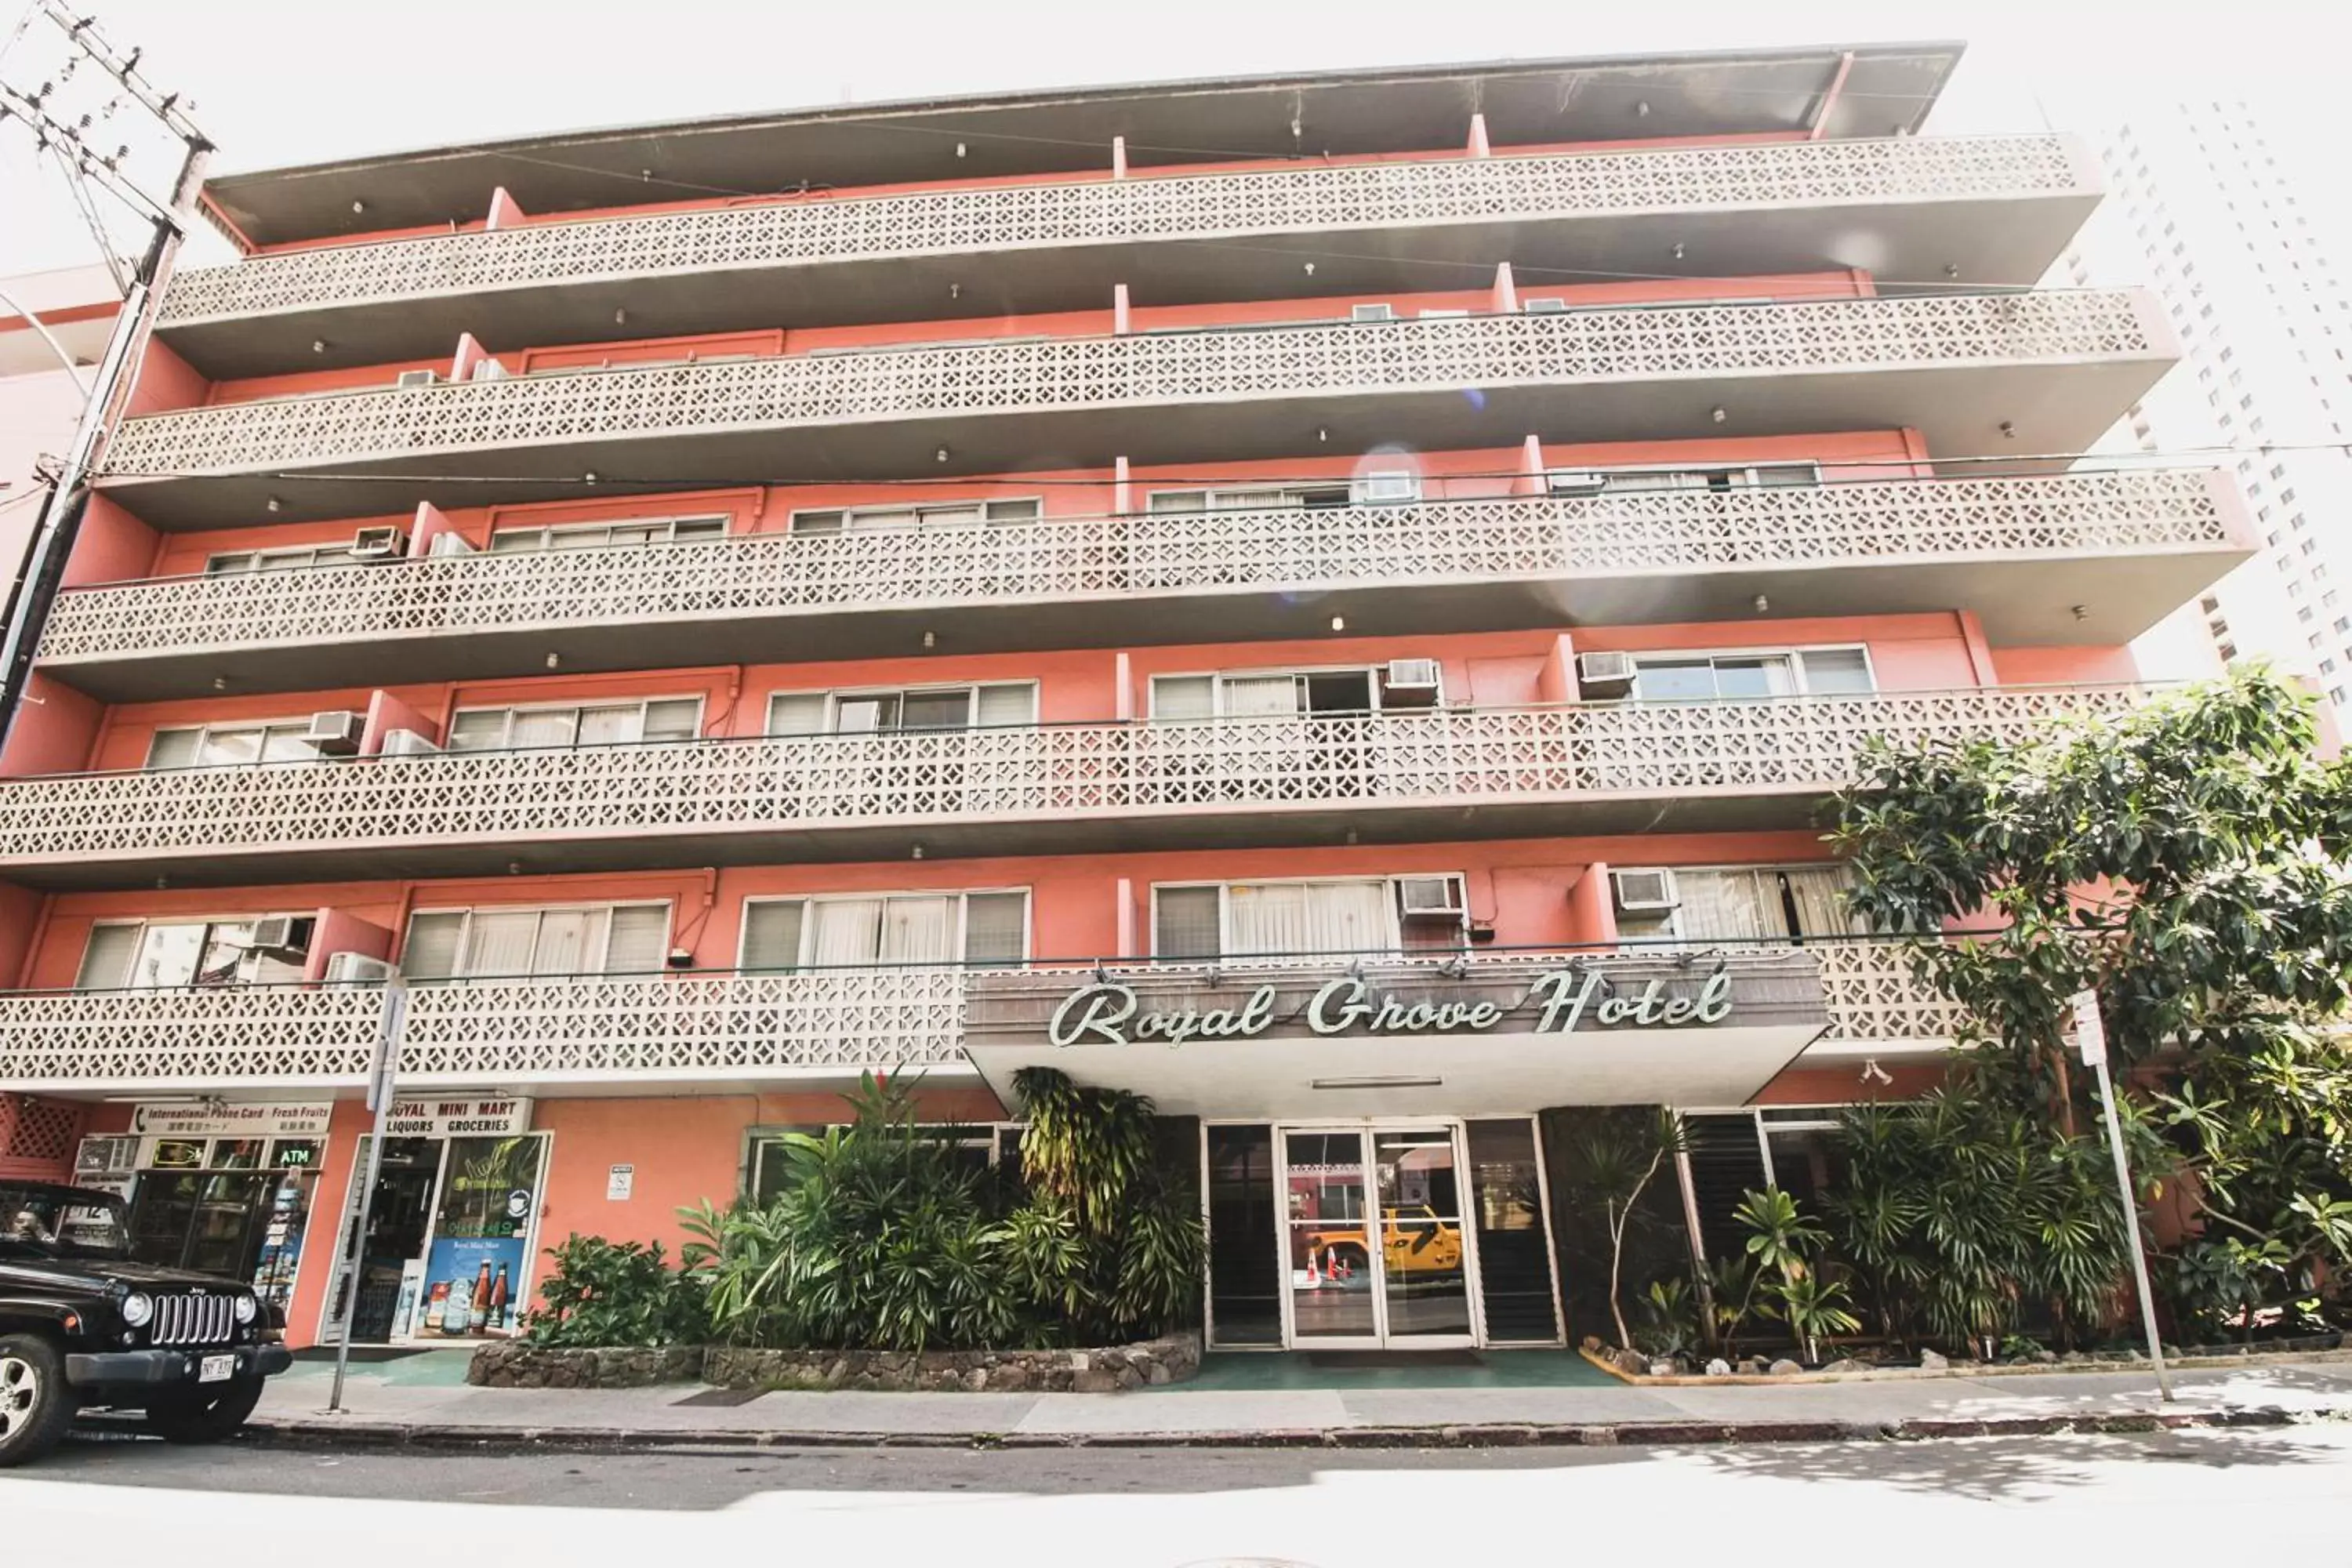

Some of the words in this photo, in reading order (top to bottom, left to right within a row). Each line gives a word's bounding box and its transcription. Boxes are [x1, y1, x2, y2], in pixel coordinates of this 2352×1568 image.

[1048, 982, 1277, 1051] Royal
[1306, 979, 1504, 1037] Grove
[1529, 967, 1735, 1035] Hotel
[241, 1107, 264, 1119] Card
[272, 1106, 298, 1118] Fresh
[300, 1106, 328, 1117] Fruits
[437, 1102, 468, 1116] MINI
[478, 1102, 517, 1115] MART
[387, 1120, 434, 1134] LIQUORS
[448, 1119, 509, 1131] GROCERIES
[281, 1150, 309, 1163] ATM
